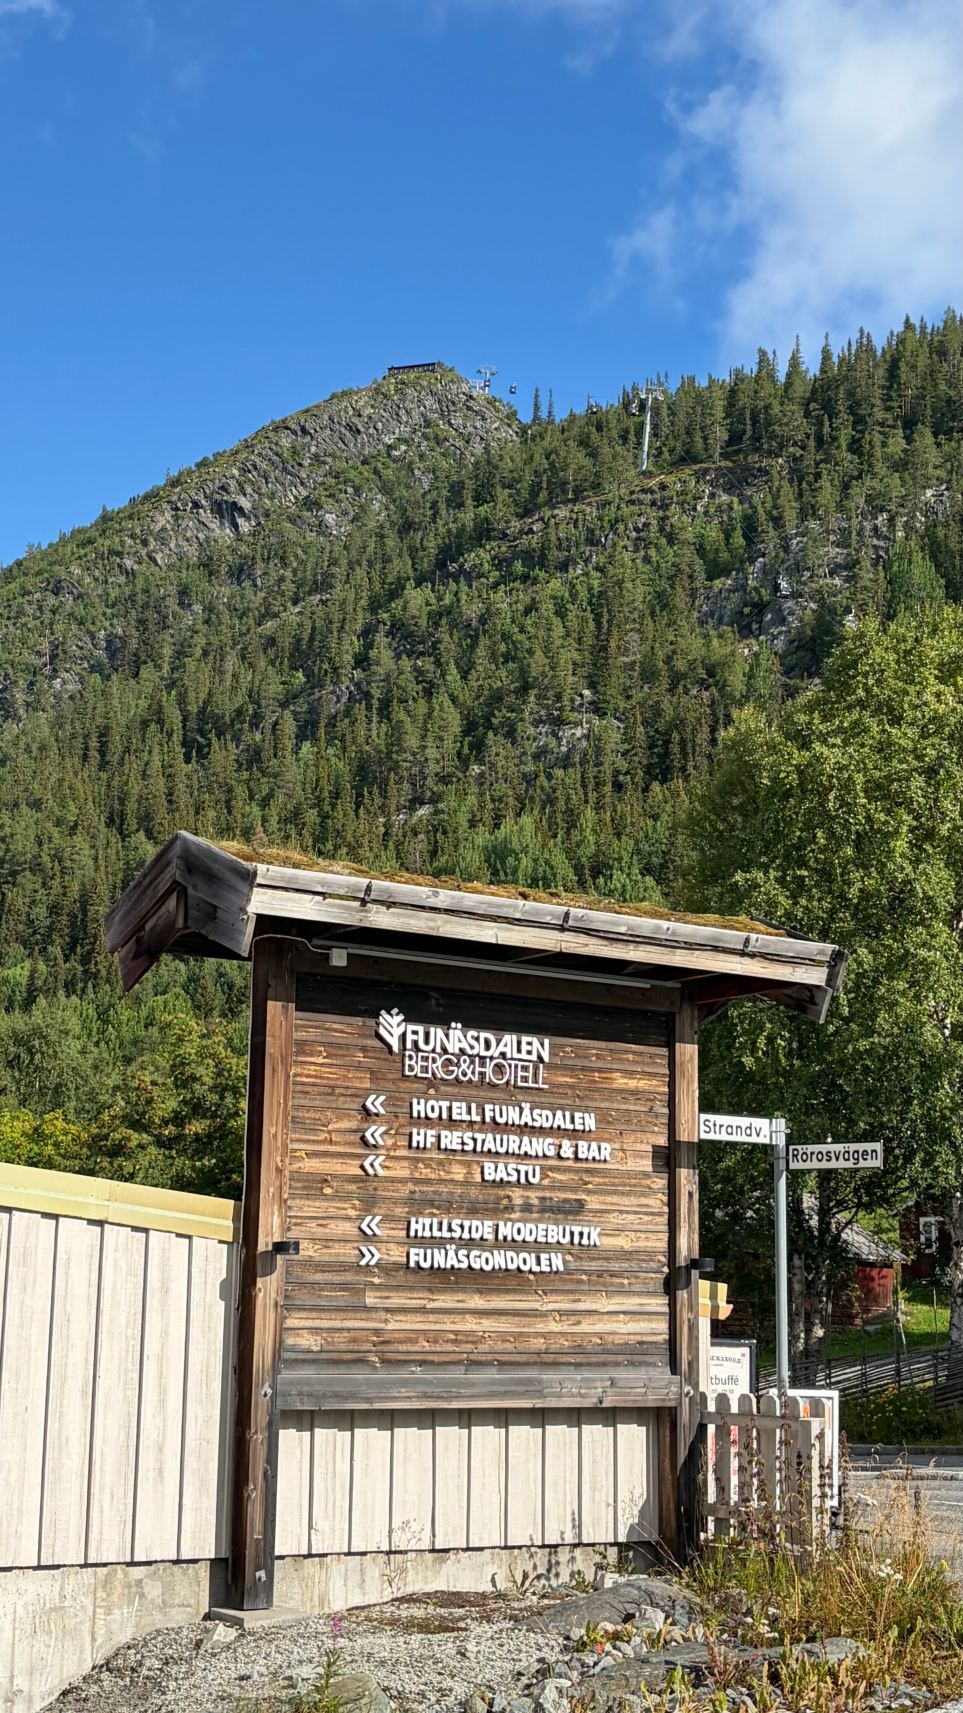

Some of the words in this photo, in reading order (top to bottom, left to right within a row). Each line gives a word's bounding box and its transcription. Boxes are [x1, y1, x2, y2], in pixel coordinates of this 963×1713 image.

[405, 1021, 550, 1062] FUNÄSDALEN
[404, 1052, 549, 1089] BERG&HOTELL
[412, 1098, 481, 1122] HOTELL
[485, 1103, 596, 1132] FUNÄSDALEN
[703, 1119, 767, 1138] Strandv.
[411, 1128, 436, 1148] HF
[440, 1130, 555, 1157] RESTAURANG
[559, 1140, 574, 1158] &
[577, 1141, 612, 1161] BAR
[791, 1146, 878, 1165] Rörosvägen
[483, 1162, 541, 1184] BASTU
[409, 1217, 494, 1239] HILLSIDE
[498, 1220, 601, 1245] MODEBUTIK
[409, 1245, 564, 1272] FUNÄSGONDOLEN
